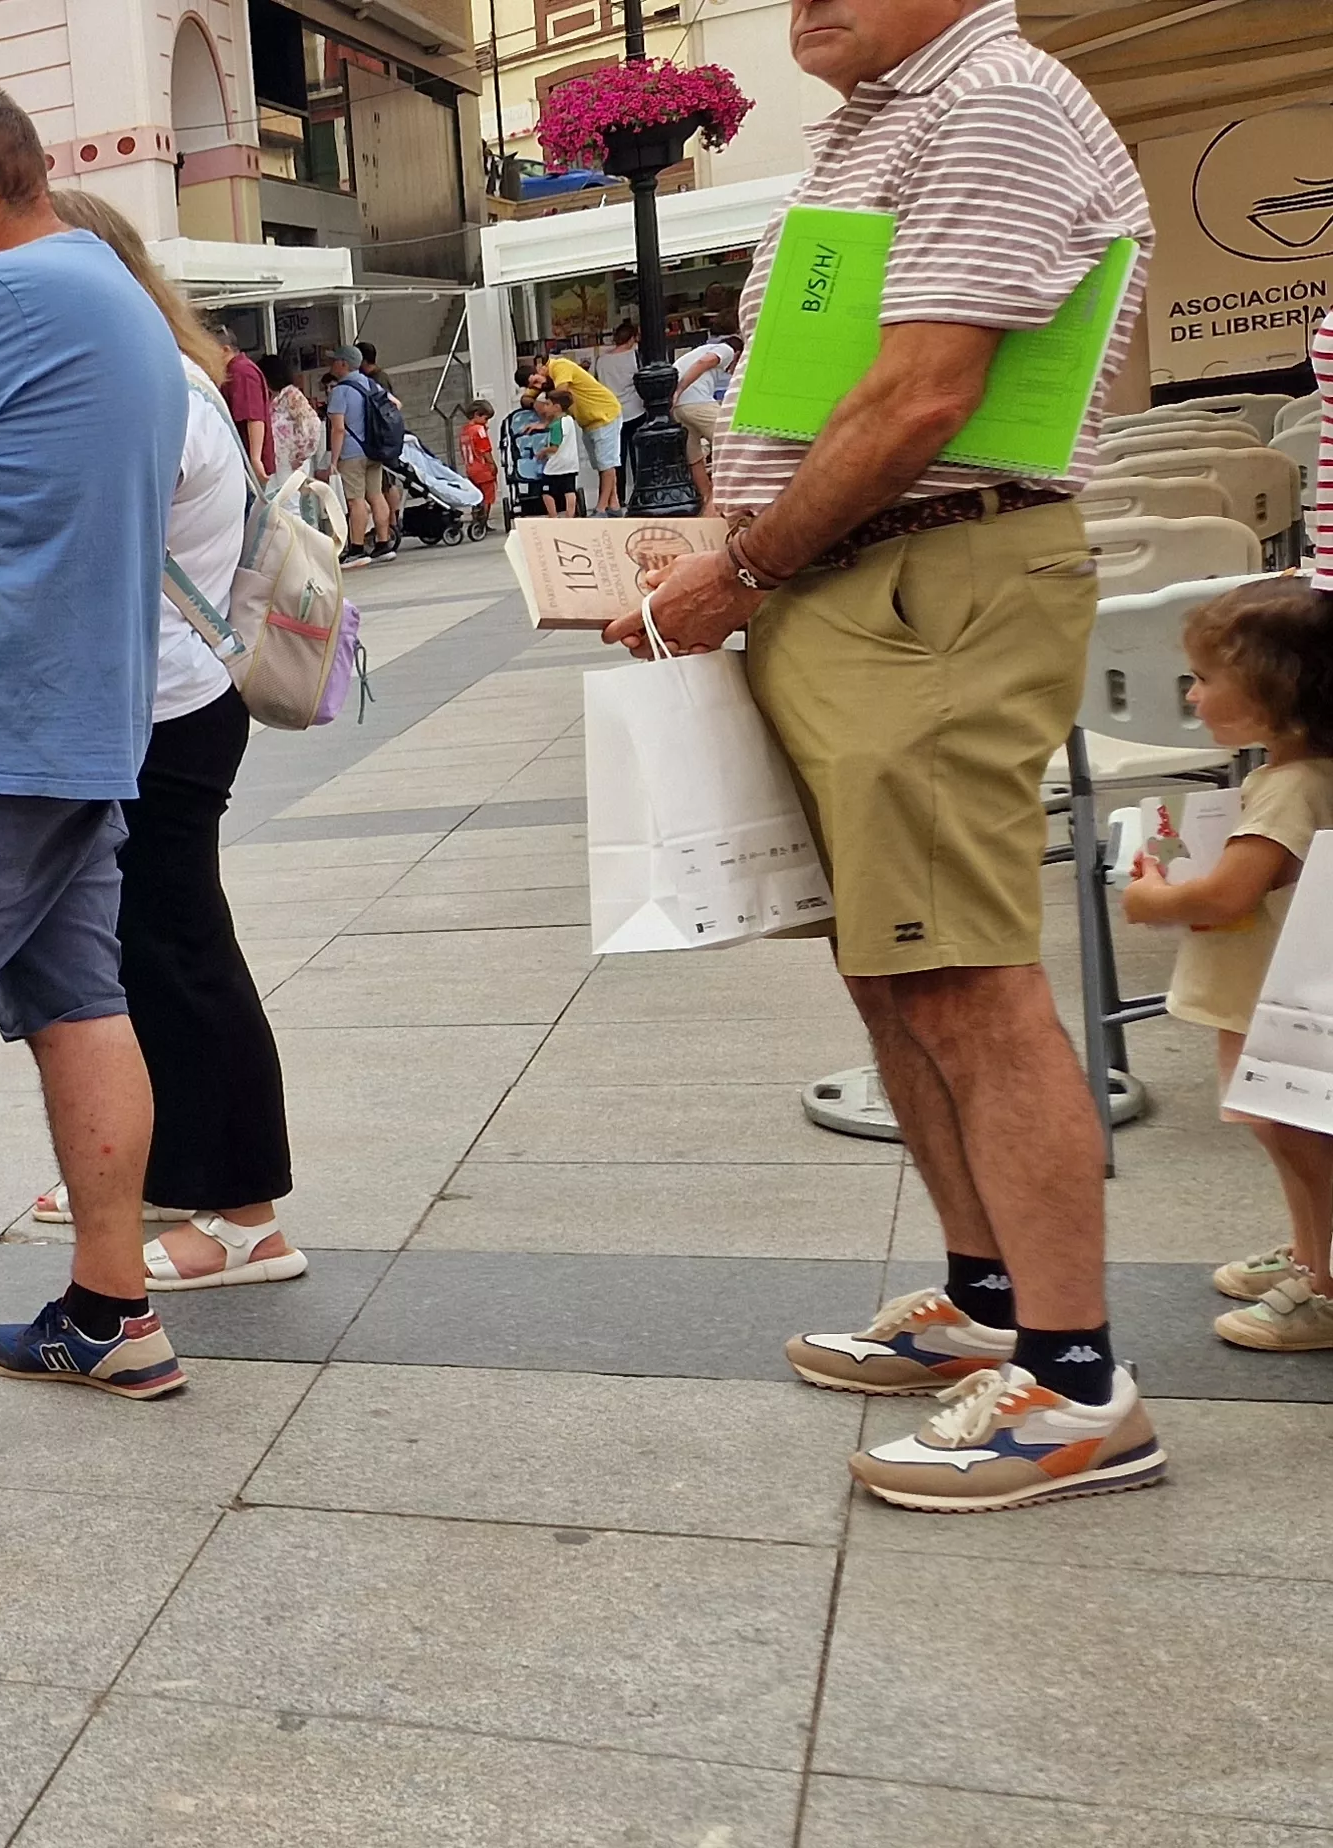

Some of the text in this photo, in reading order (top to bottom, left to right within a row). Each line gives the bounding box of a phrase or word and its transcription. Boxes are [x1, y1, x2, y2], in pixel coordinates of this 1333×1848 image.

[801, 243, 838, 312] B/S/H/
[1169, 280, 1326, 318] ASOCIACIÓN
[1171, 323, 1203, 342] DE
[553, 537, 599, 594] 1137
